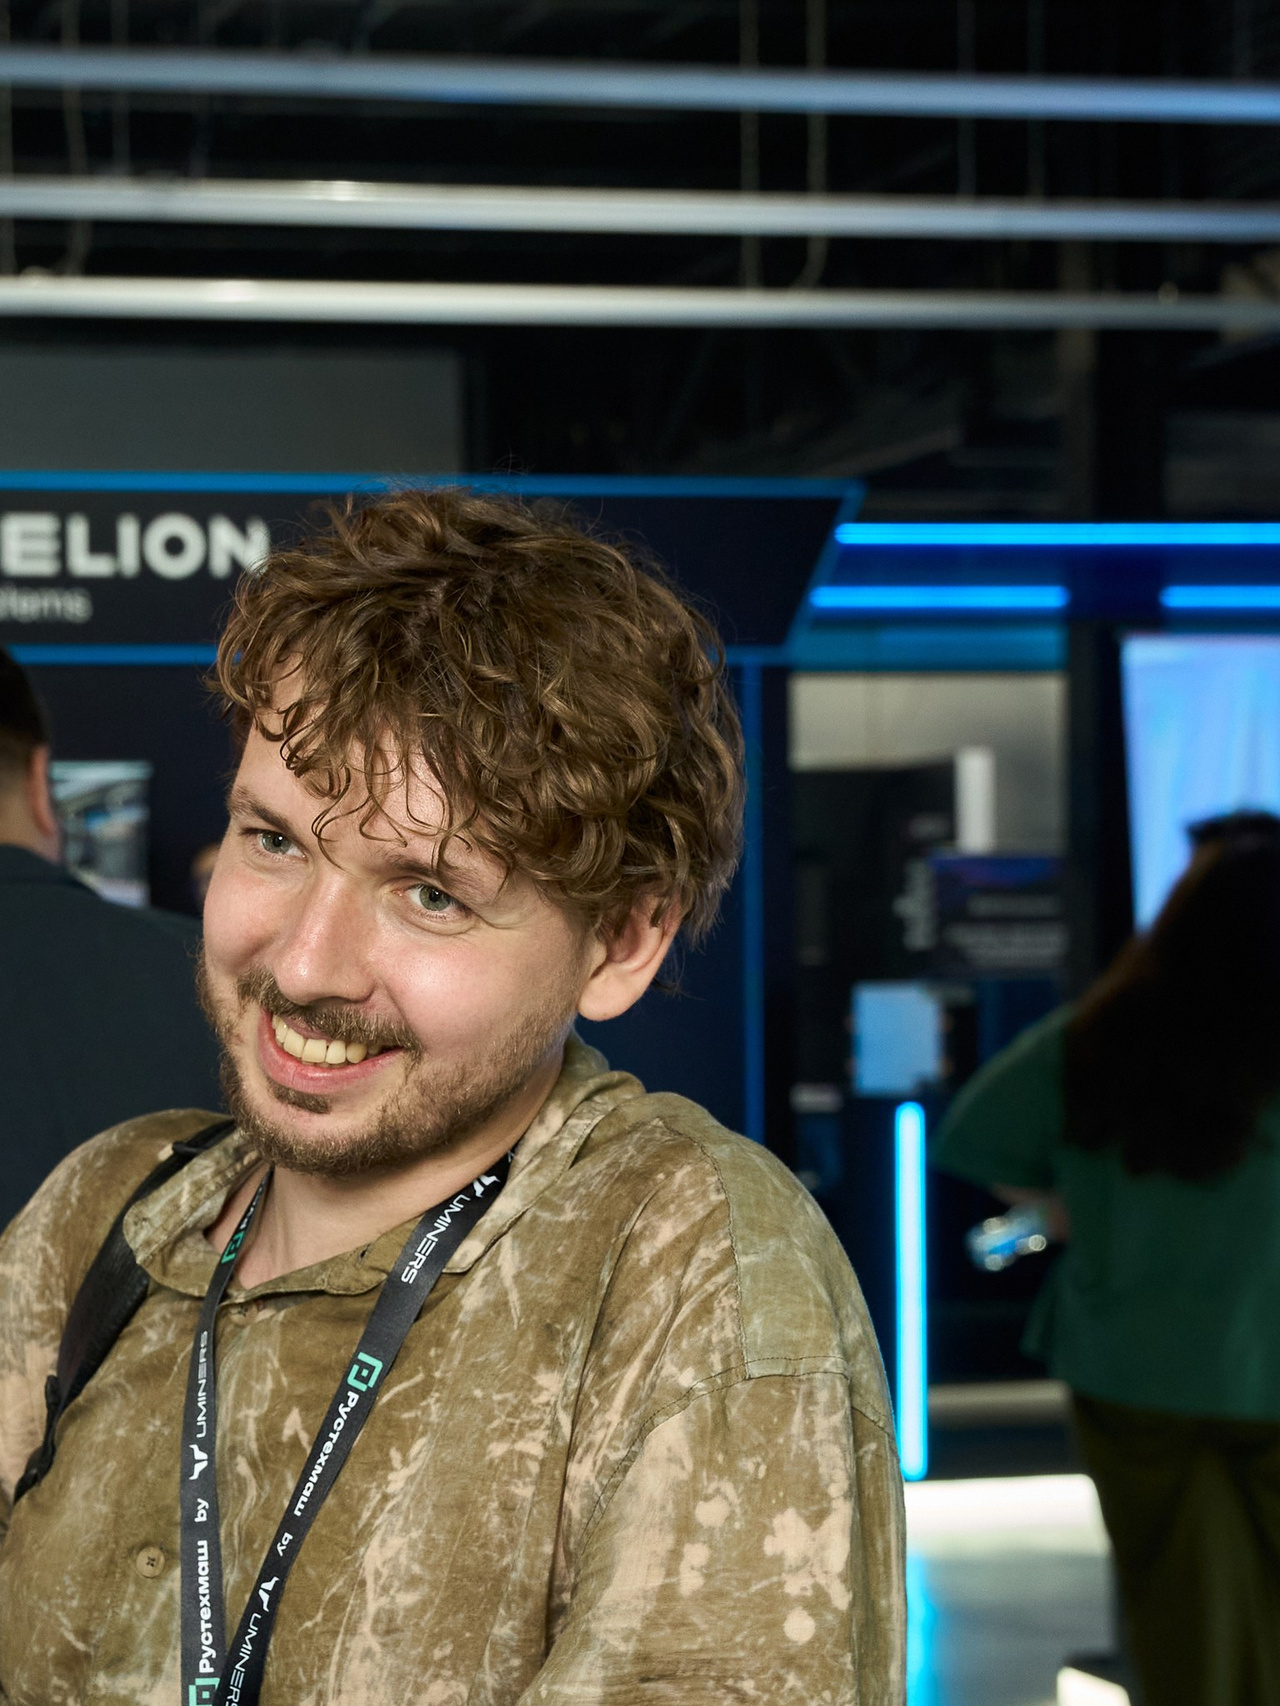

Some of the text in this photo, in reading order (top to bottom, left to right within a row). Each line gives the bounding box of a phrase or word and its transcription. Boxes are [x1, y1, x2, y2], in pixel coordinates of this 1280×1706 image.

[401, 1194, 471, 1284] UMINERS
[194, 1330, 217, 1674] Рустехмаш by UMINERS
[293, 1391, 360, 1517] Рустехмаш
[276, 1532, 294, 1557] by
